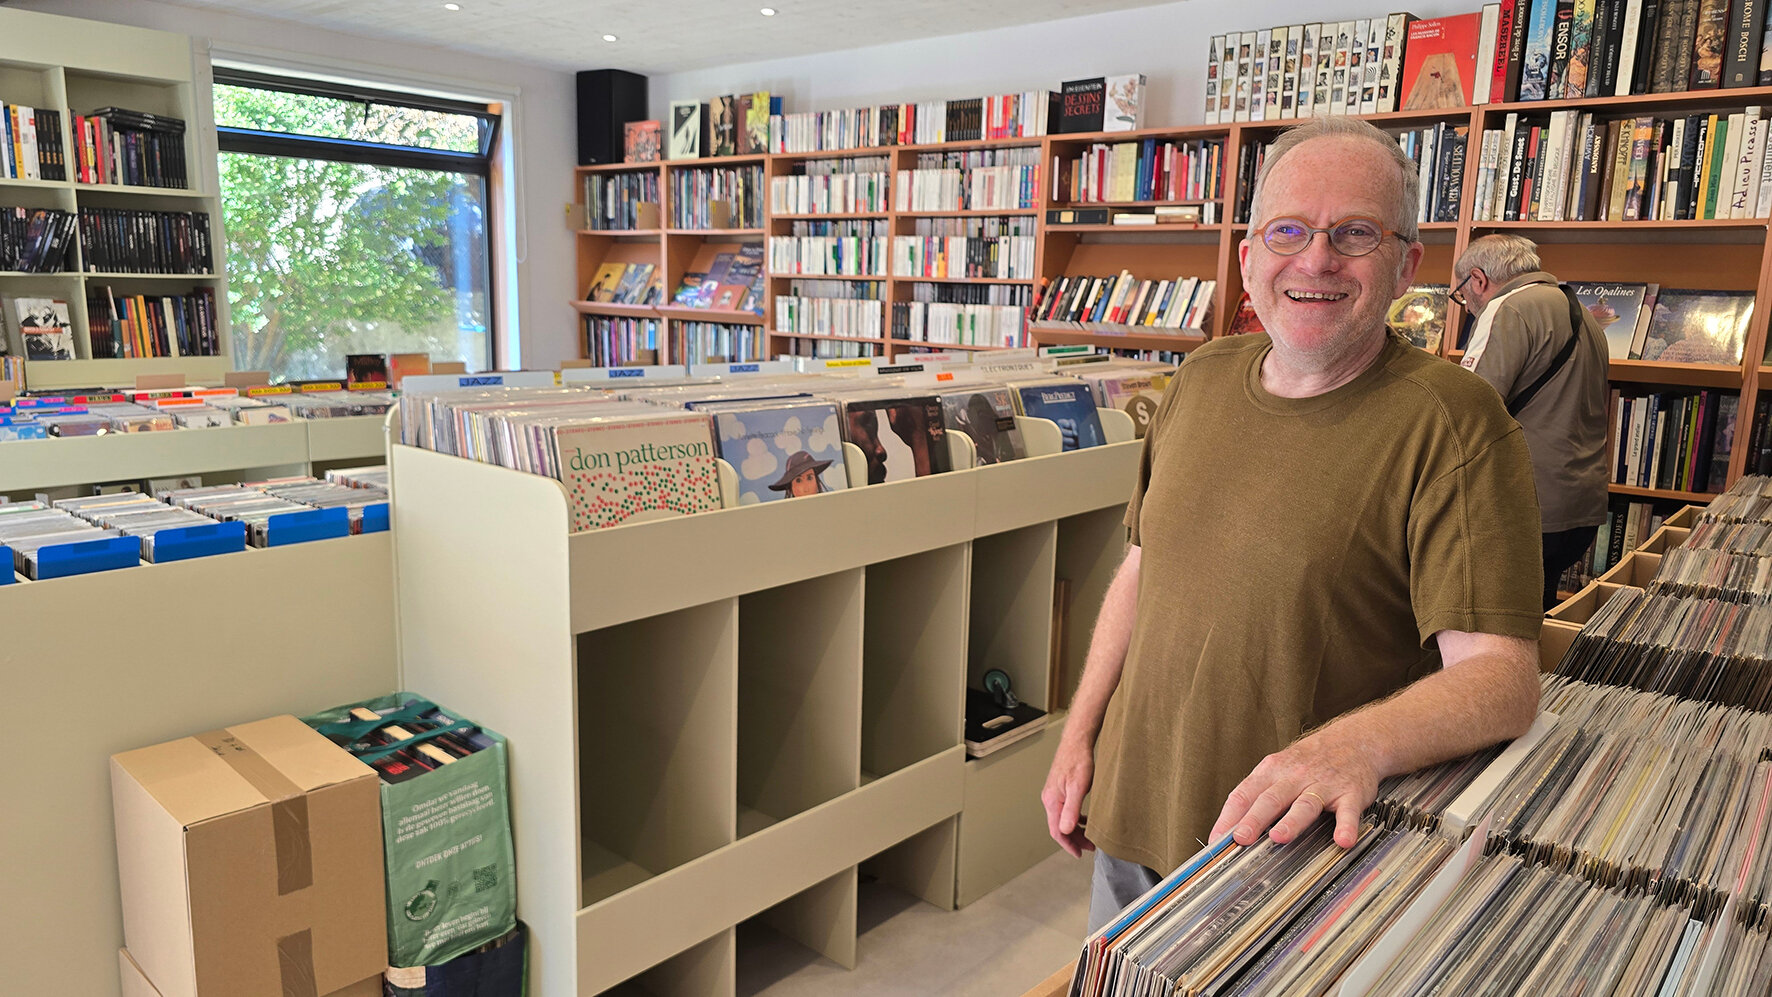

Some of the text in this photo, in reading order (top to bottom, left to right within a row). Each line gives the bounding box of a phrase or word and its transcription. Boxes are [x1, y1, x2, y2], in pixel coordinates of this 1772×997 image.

[1514, 6, 1524, 29] Leonor
[1496, 9, 1511, 72] MASEREEL
[1511, 38, 1520, 52] livre
[1513, 29, 1521, 38] de
[1555, 21, 1569, 60] ENSOR
[1737, 31, 1750, 62] BOSCH
[1511, 52, 1519, 61] Le
[1063, 104, 1100, 117] SECRETS
[1064, 91, 1102, 106] DESSINS
[1590, 135, 1601, 174] KANDINSKY
[1682, 117, 1698, 166] DELVAUX
[1448, 144, 1464, 202] RIK WOUTERS
[1510, 136, 1525, 198] Gust. De Smet
[1731, 119, 1758, 209] Adieu Picasso
[1576, 285, 1636, 299] Les Opalines
[461, 377, 502, 387] JAZZ
[611, 369, 644, 378] JAZZ
[1135, 401, 1150, 425] S
[570, 441, 709, 474] don patterson
[1612, 513, 1624, 551] SNYDERS
[398, 811, 431, 827] allemaal
[449, 792, 472, 805] willen
[472, 785, 490, 797] doen
[412, 798, 438, 812] Omdat
[448, 781, 479, 797] vandaag
[396, 832, 415, 844] deze
[429, 818, 449, 831] 100%
[405, 823, 415, 832] de
[415, 811, 448, 829] geweven
[416, 852, 442, 869] ONTDEK
[442, 845, 460, 859] ONZE
